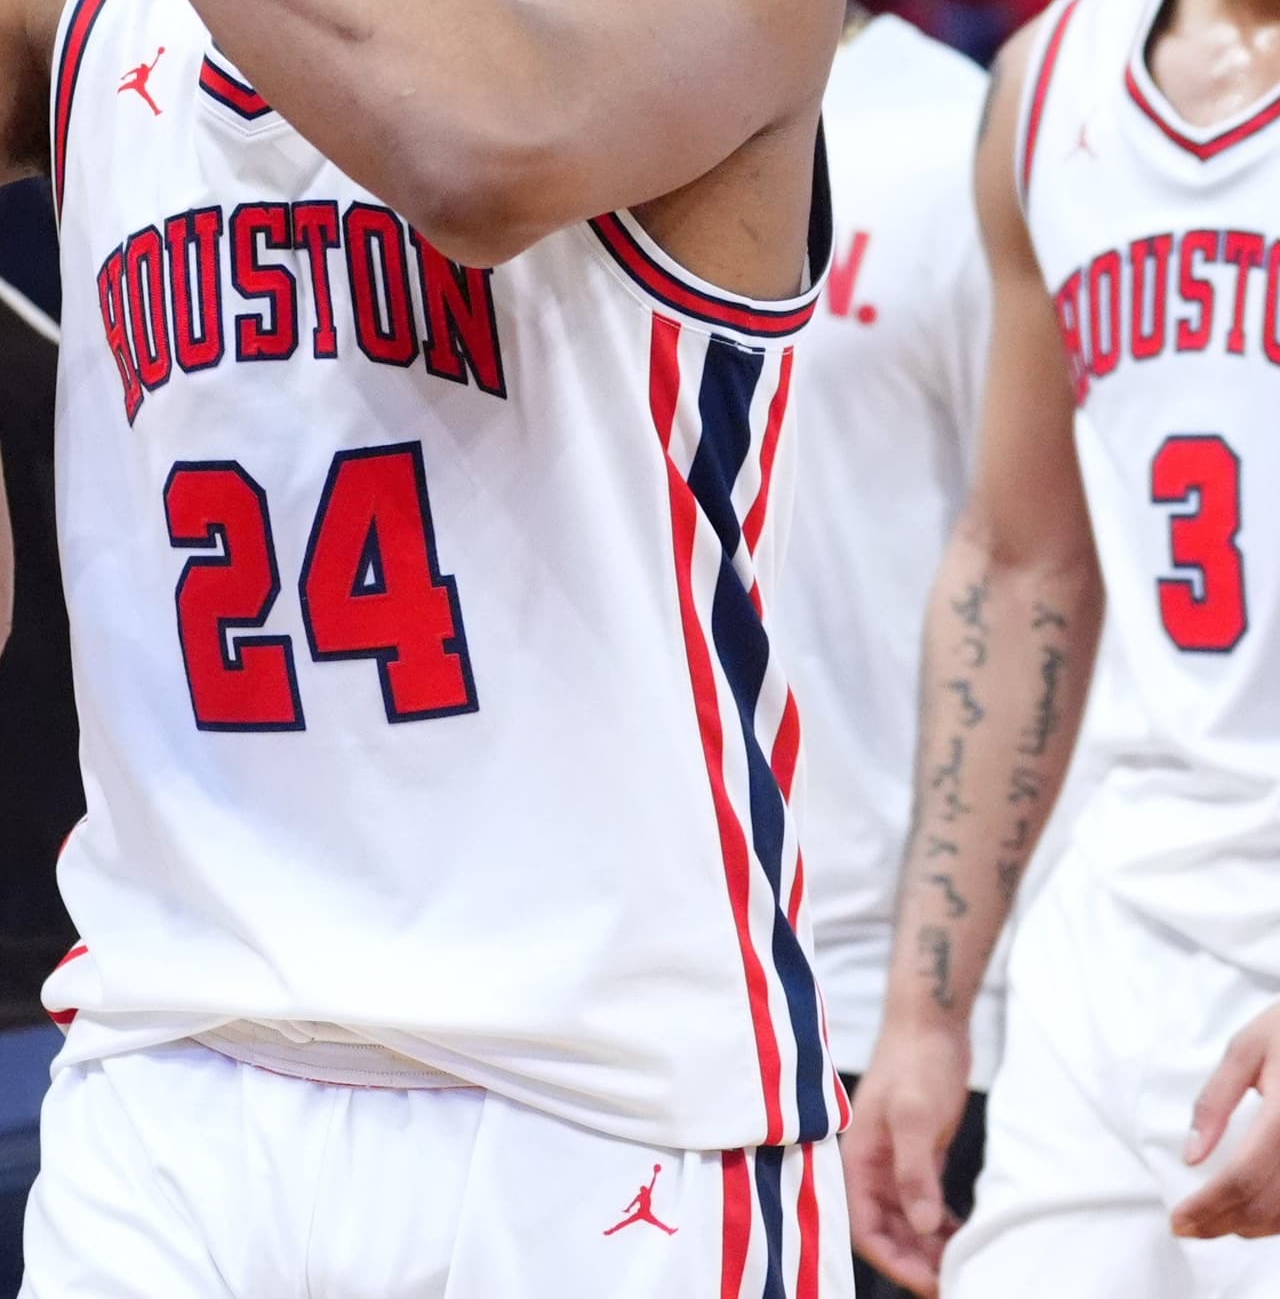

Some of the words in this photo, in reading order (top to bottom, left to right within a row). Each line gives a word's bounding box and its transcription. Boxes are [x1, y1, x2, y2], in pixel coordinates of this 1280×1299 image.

[97, 200, 507, 428] HOUSTON
[163, 440, 480, 732] 24
[1152, 435, 1248, 654] 3
